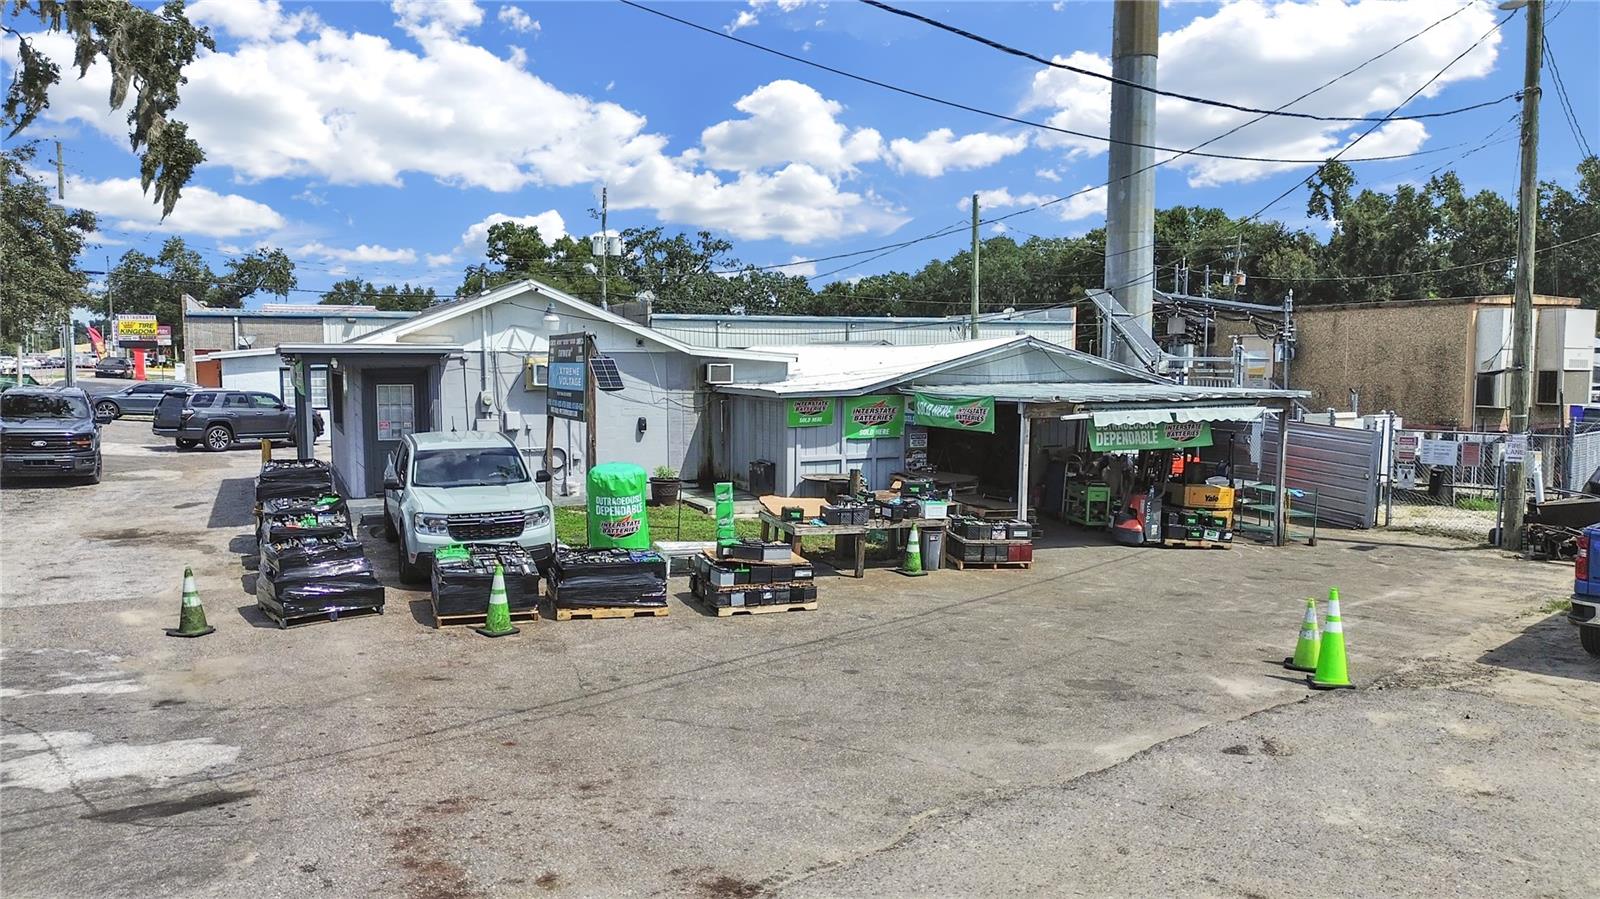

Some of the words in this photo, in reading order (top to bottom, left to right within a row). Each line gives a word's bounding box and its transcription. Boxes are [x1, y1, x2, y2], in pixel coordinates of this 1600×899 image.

[559, 367, 580, 376] XTREME
[558, 375, 582, 386] VOLTAGE
[853, 406, 897, 415] INTERSTATE
[932, 404, 953, 418] HERE
[854, 414, 894, 422] BATTERIES
[1165, 423, 1201, 431] INTERSTATE
[1096, 430, 1159, 446] DEPENDABLE
[1204, 494, 1219, 502] Yale
[595, 502, 643, 516] DEPENDABLE
[600, 519, 641, 529] INTERSTATE
[602, 526, 640, 534] BATTERIES
